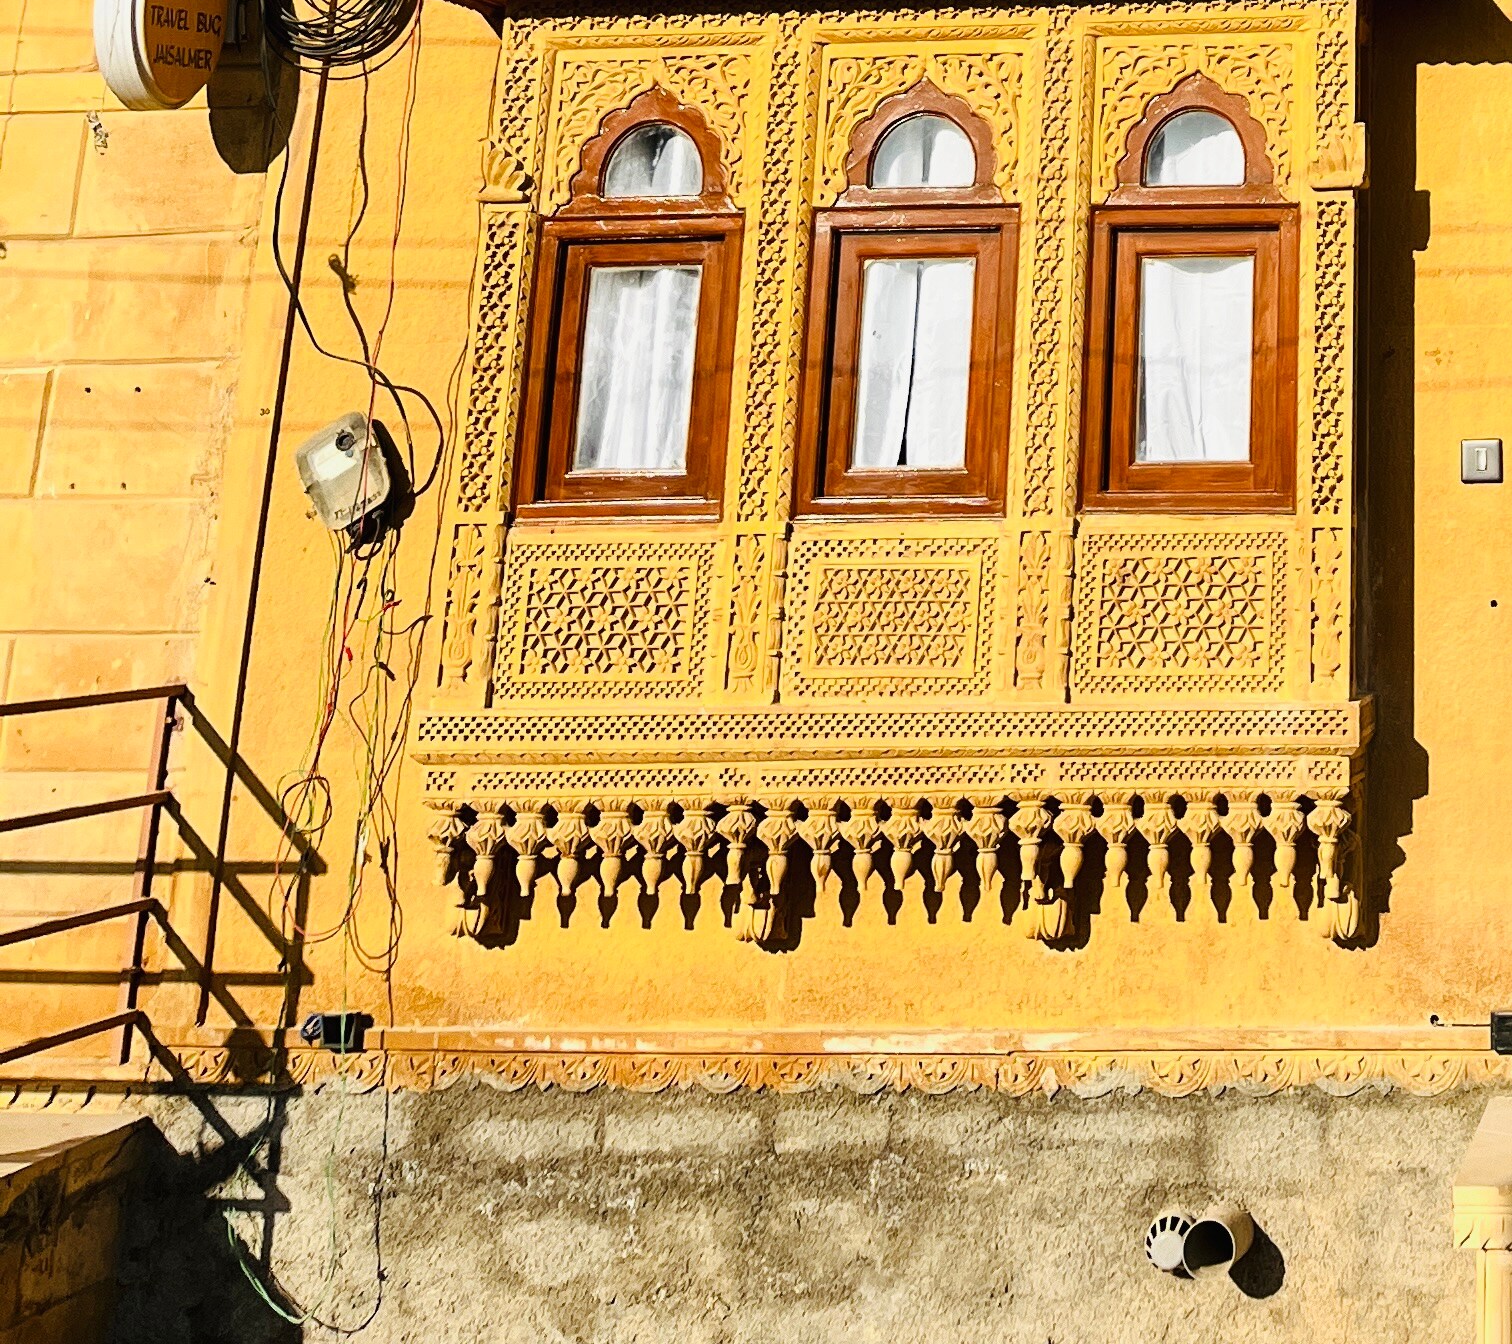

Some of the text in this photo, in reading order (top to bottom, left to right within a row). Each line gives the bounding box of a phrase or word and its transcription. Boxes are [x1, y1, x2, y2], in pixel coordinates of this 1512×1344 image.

[150, 4, 222, 37] TRAVEL BUG
[153, 43, 213, 72] JAISALMER
